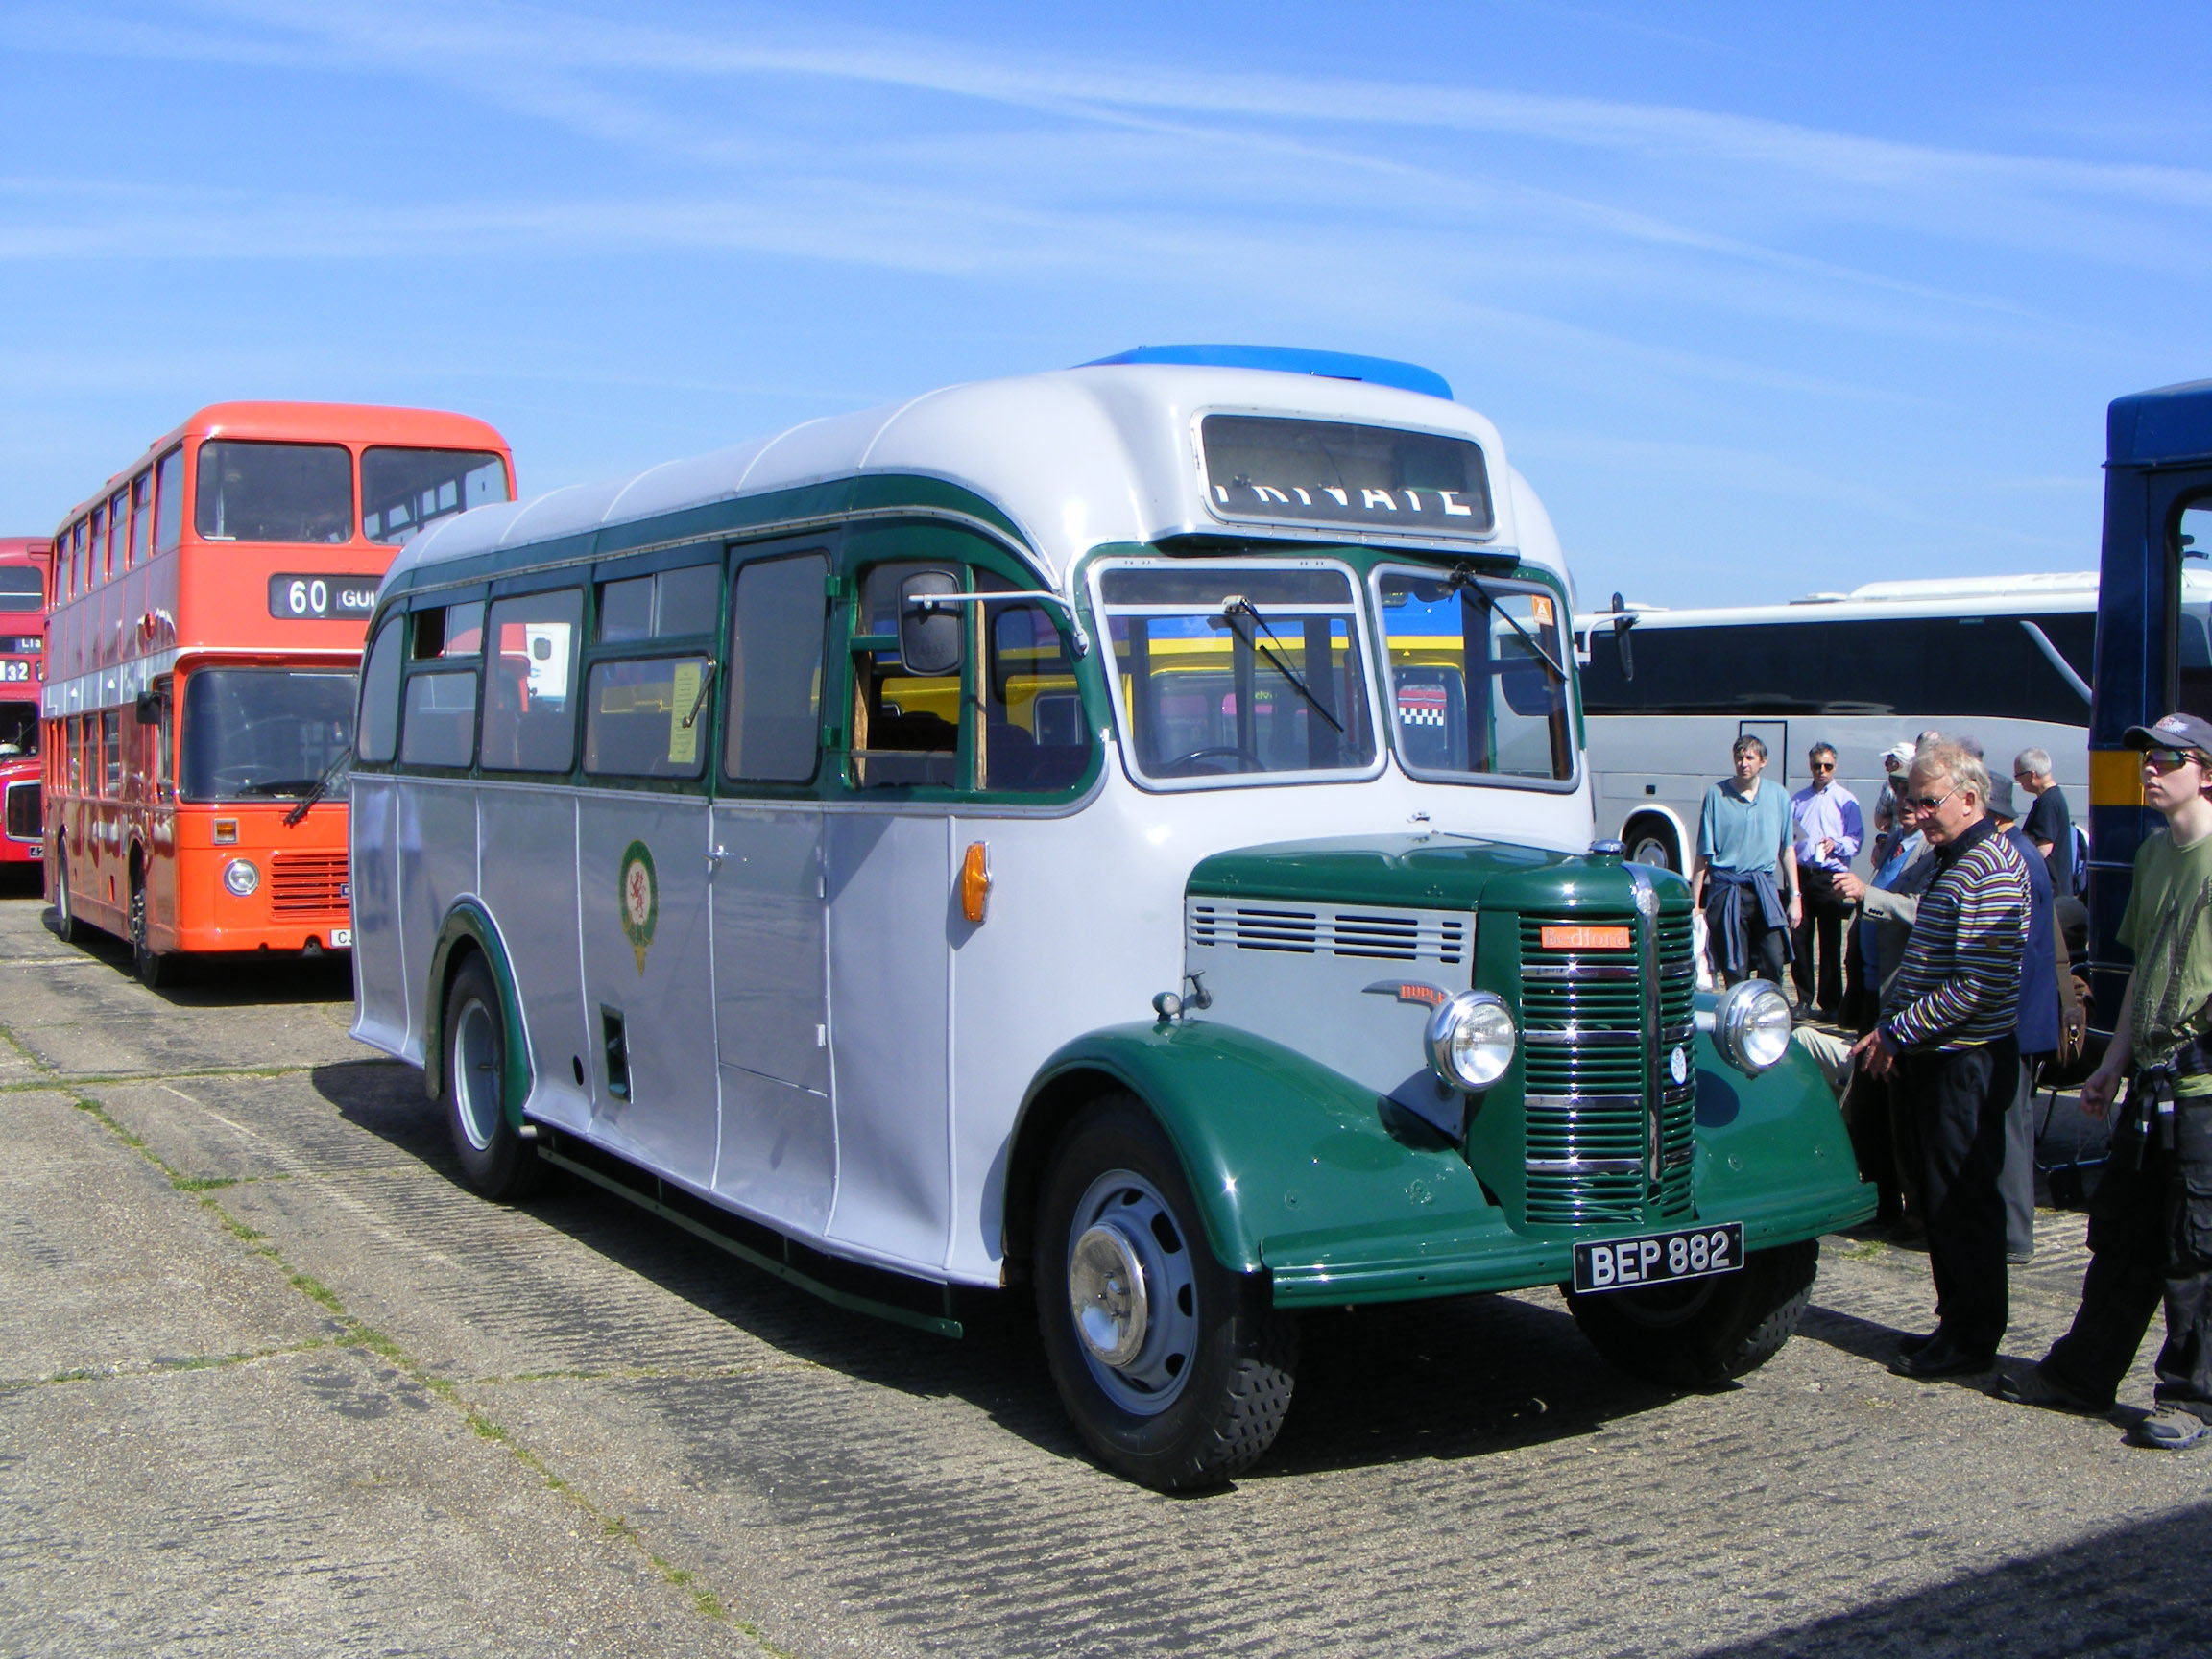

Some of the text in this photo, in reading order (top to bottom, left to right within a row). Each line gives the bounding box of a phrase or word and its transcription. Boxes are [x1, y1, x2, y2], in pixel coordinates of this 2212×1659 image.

[289, 580, 326, 613] 60
[1545, 927, 1626, 947] Bedford
[1591, 1230, 1730, 1286] BEP 882
